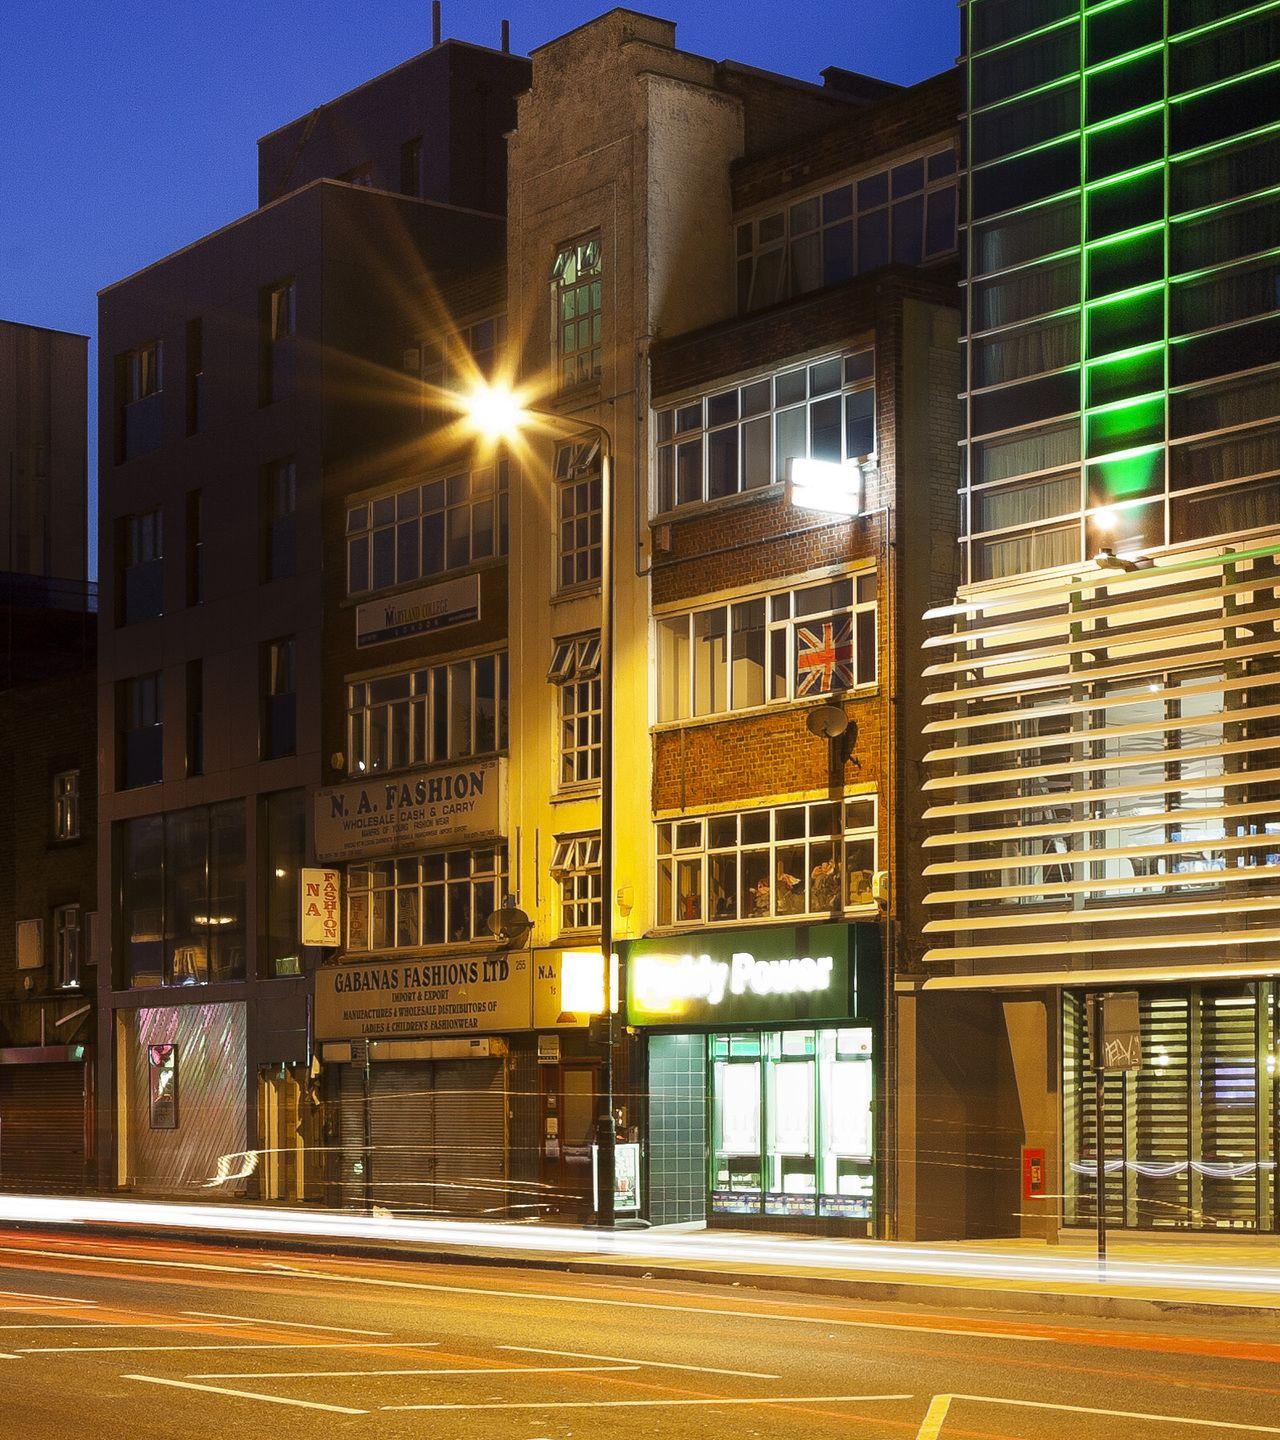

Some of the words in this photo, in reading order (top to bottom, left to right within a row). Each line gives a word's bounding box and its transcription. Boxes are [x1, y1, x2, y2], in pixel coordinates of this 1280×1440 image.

[330, 794, 349, 819] N.
[357, 790, 378, 815] A.
[385, 770, 486, 811] FASHION
[343, 813, 396, 831] WHOLESALE
[400, 809, 425, 823] CASH
[430, 807, 437, 817] &
[442, 801, 475, 815] CARRY
[323, 872, 338, 938] FASHION
[334, 969, 399, 993] GABANAS
[404, 960, 479, 989] FASHIONS
[482, 958, 510, 983] LTD
[731, 952, 834, 995] Power
[343, 1008, 393, 1021] MANUFACTURES
[399, 1005, 437, 1017] WHOLESALE
[438, 1002, 487, 1015] DISTRIBUTORS
[488, 1001, 498, 1012] OF
[392, 991, 416, 1003] IMPORT
[417, 991, 423, 1001] &
[424, 989, 450, 1001] EXPORT
[361, 1022, 385, 1033] LADIES
[430, 1018, 478, 1031] FASHIONWEAR
